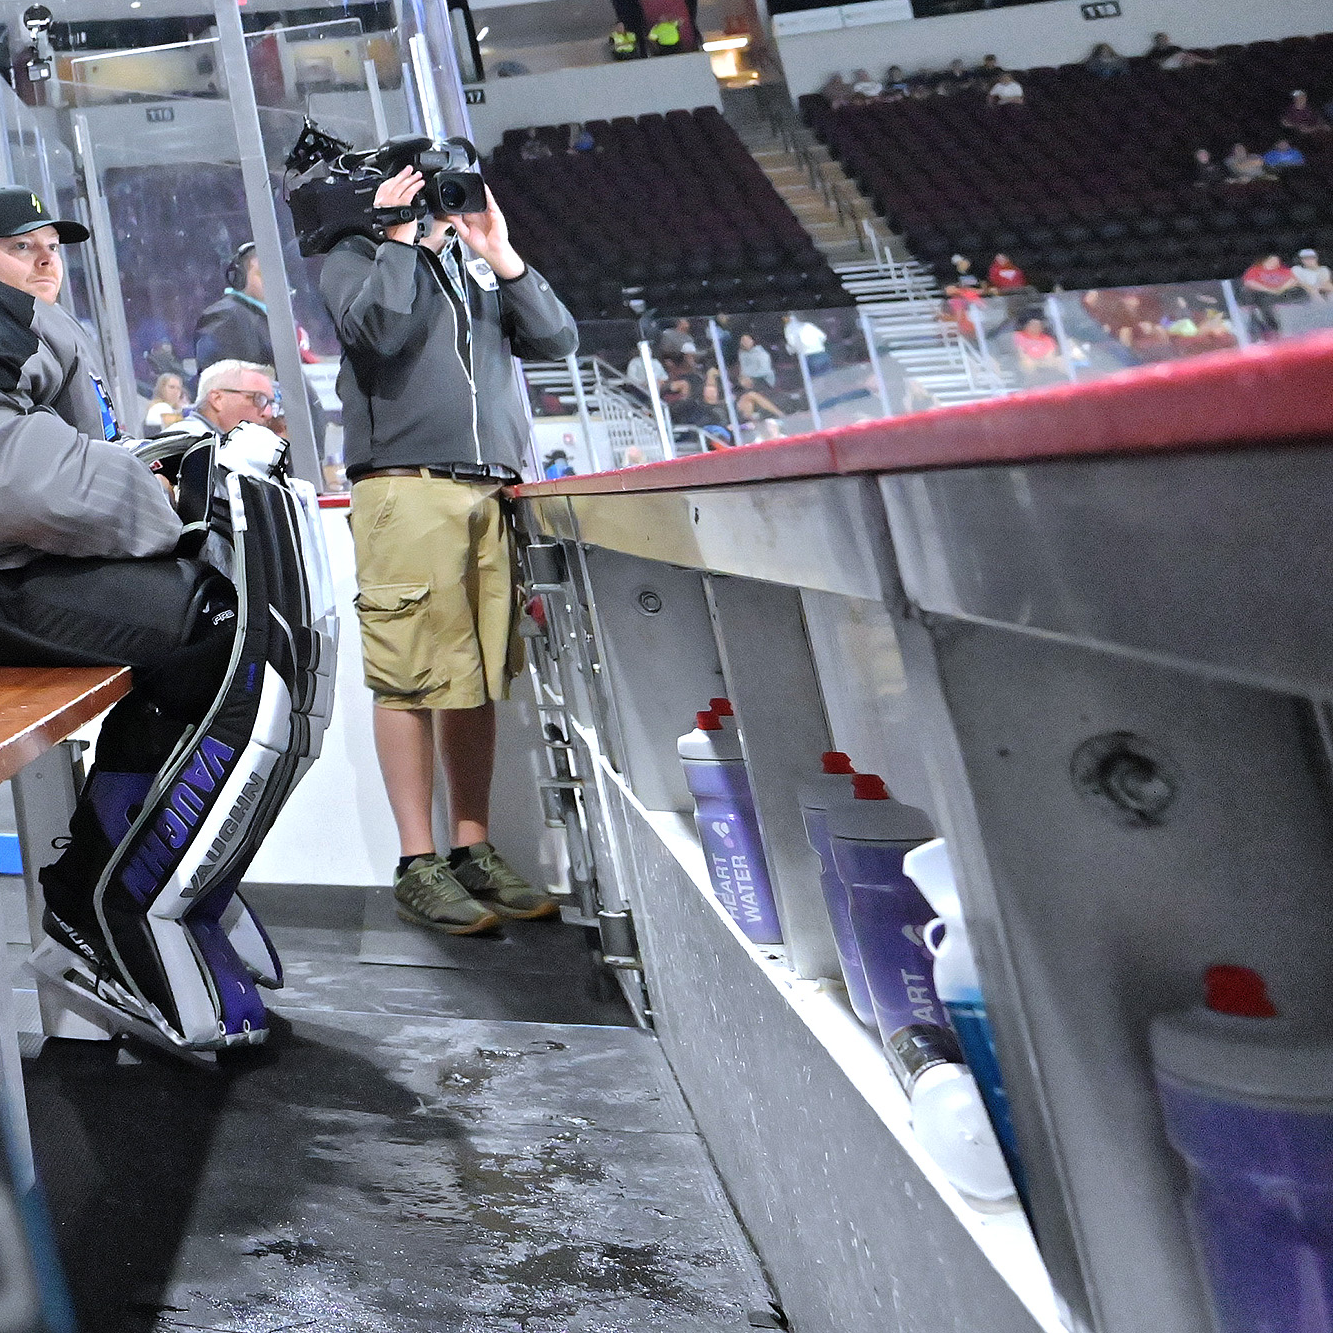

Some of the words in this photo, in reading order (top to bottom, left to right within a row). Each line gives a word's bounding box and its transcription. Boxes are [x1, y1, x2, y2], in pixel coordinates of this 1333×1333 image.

[120, 734, 237, 906] VAUGHN
[179, 770, 268, 900] VAUGHN
[730, 855, 762, 923] WATER
[50, 910, 100, 965] auer
[900, 968, 938, 1025] ART
